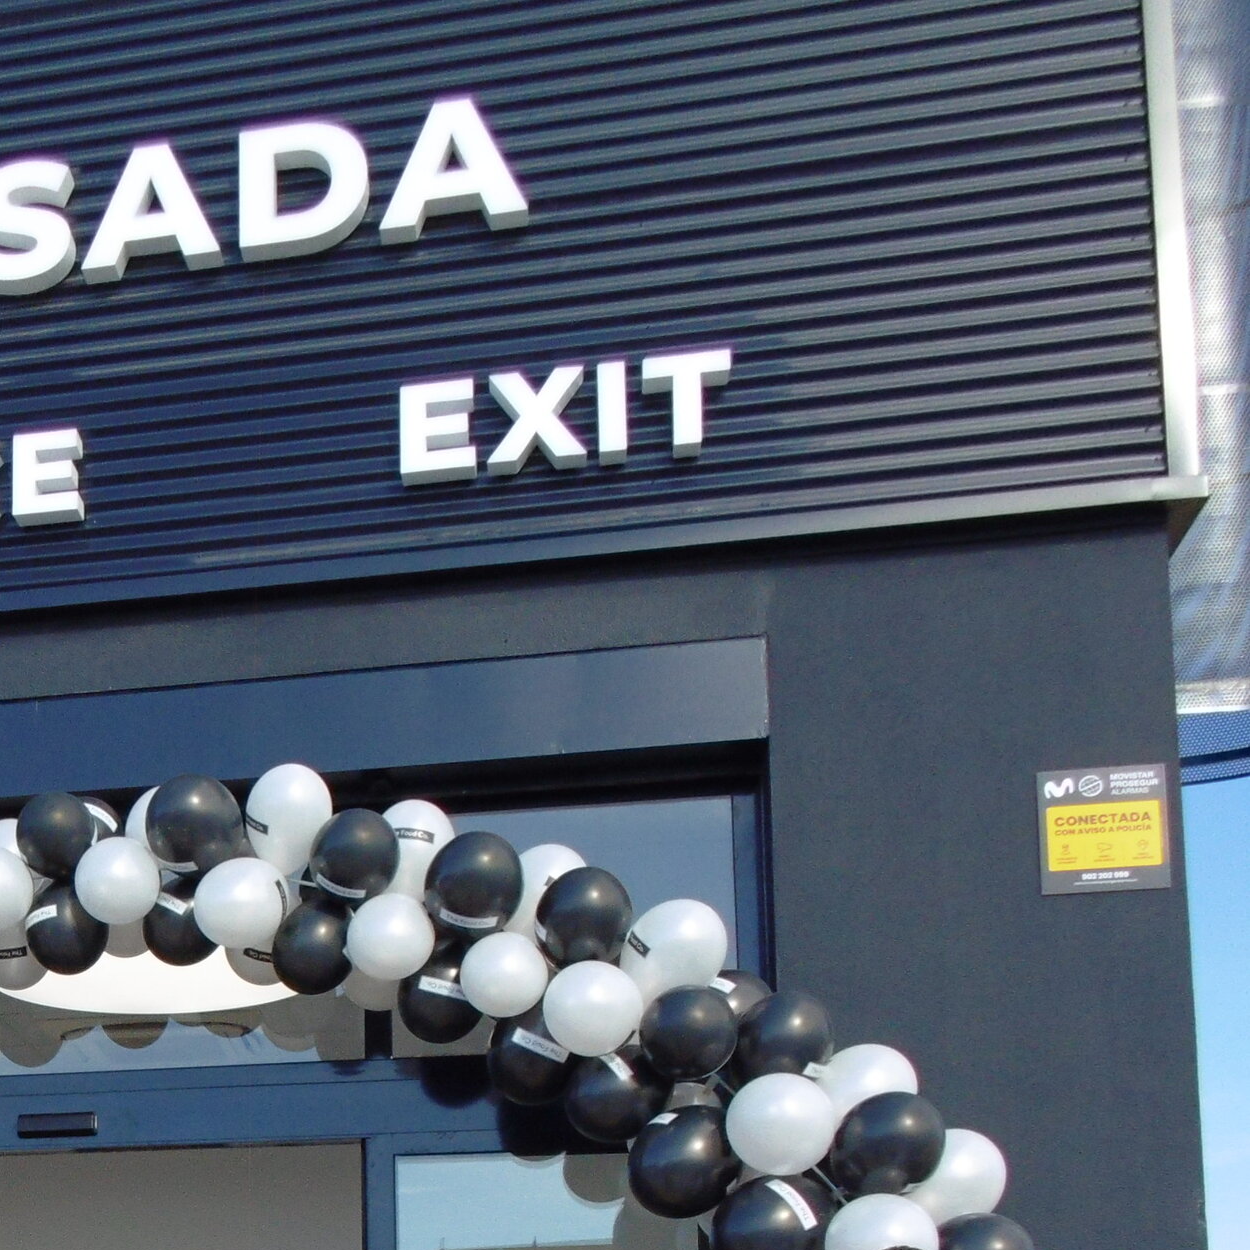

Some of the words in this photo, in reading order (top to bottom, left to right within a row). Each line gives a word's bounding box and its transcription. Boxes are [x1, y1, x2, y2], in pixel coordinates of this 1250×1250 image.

[400, 349, 731, 486] EXIT
[1110, 771, 1154, 780] MOVISTAR
[1110, 778, 1158, 788] PROSEGUR
[1054, 811, 1151, 827] CONECTADA
[1055, 828, 1075, 836] CON
[1078, 827, 1106, 835] AVISO
